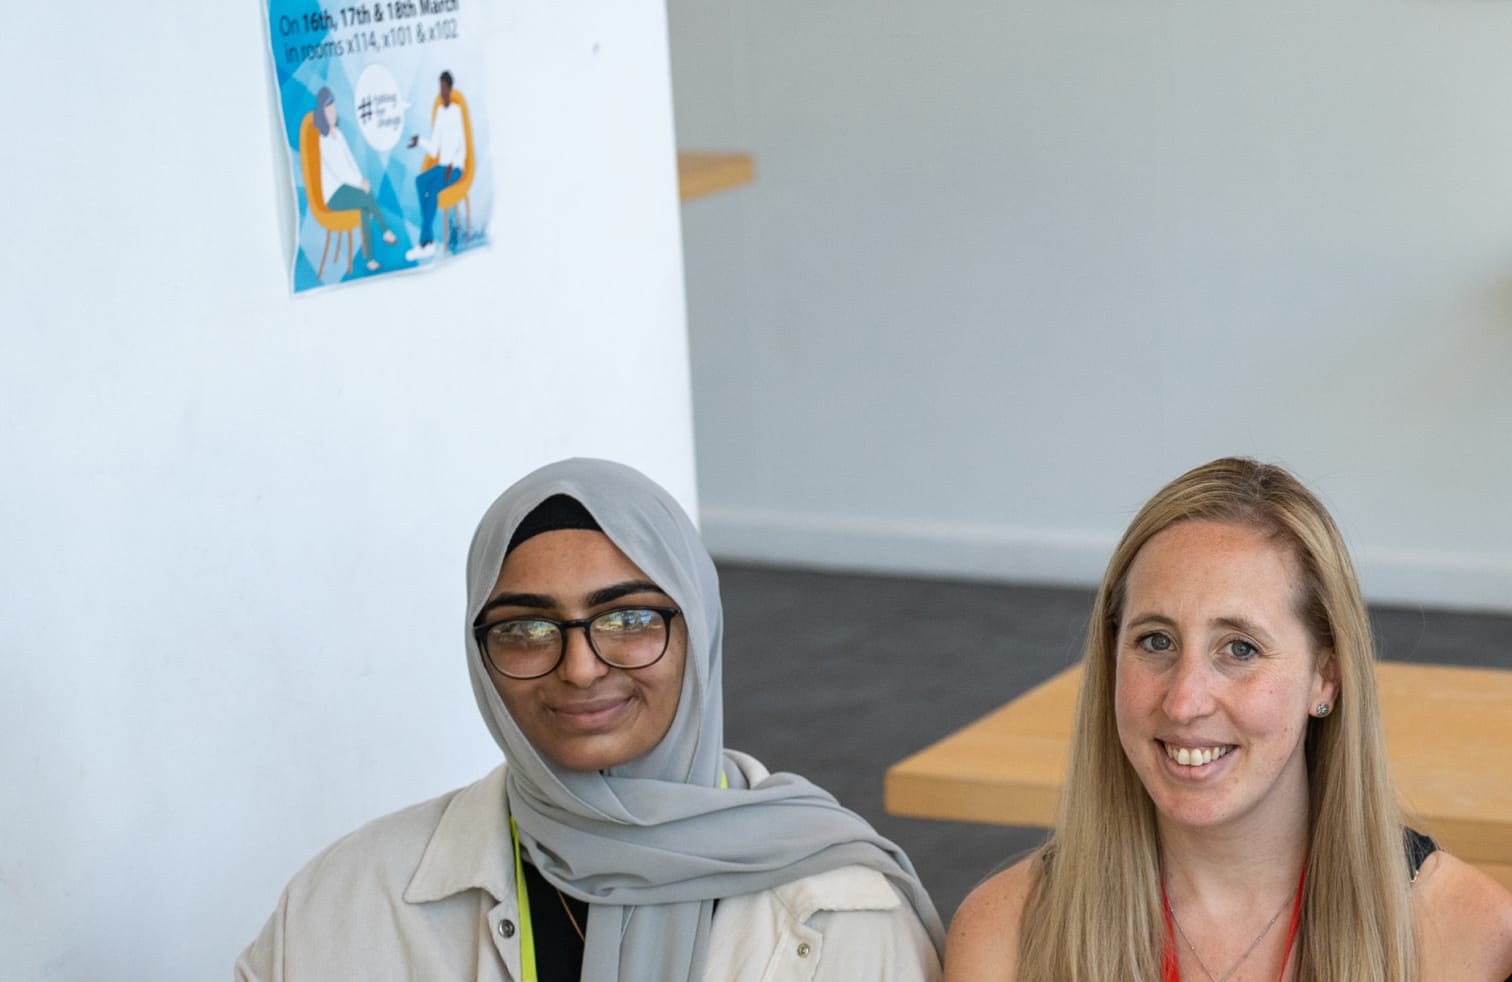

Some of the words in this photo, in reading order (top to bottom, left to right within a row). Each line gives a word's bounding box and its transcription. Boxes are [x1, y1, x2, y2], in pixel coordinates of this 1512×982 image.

[279, 14, 300, 37] On
[302, 8, 338, 33] 16th,
[340, 4, 371, 27] 17th
[373, 3, 384, 22] &
[283, 42, 300, 64] in
[301, 40, 345, 61] rooms
